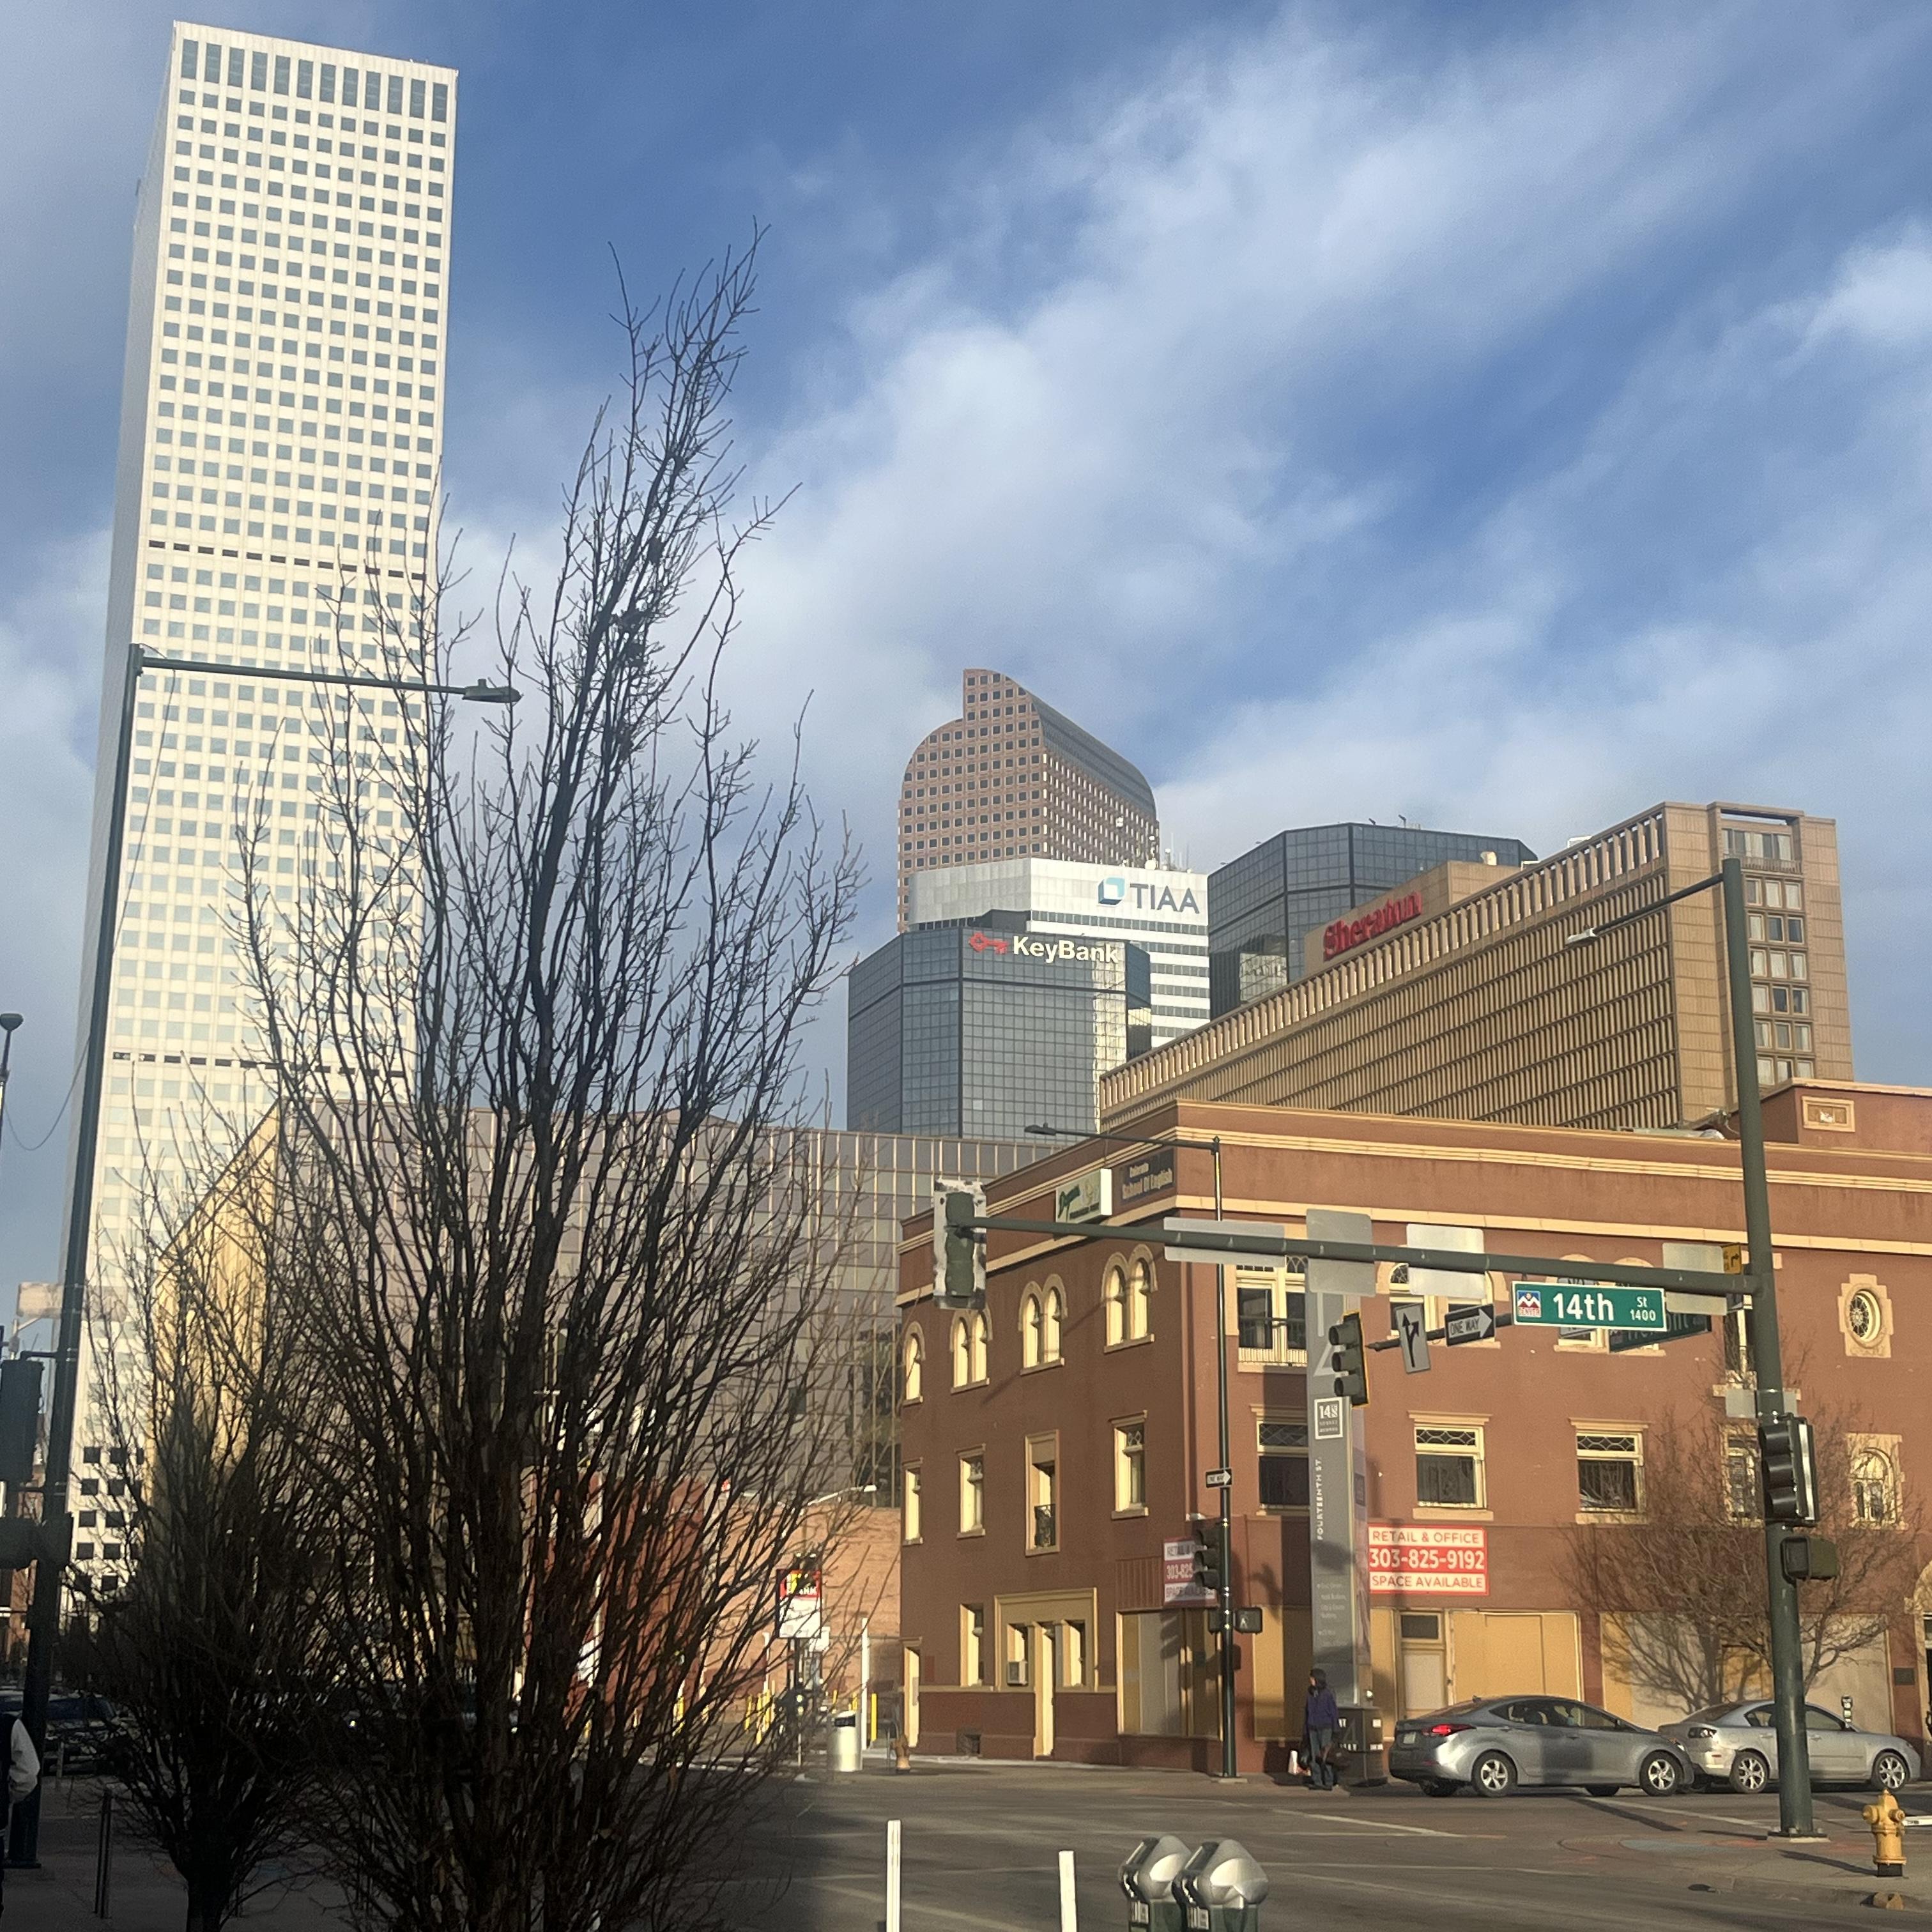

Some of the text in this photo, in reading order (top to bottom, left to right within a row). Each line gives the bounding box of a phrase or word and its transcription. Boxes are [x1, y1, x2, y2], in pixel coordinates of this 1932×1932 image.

[1130, 883, 1200, 914] TIAA
[1324, 891, 1422, 961] Sheraton
[1013, 935, 1119, 963] KeyBank
[1553, 1292, 1647, 1321] 14th St
[1630, 1309, 1656, 1322] 1400
[1450, 1316, 1480, 1335] ONE WAY
[1315, 1474, 1324, 1540] FOURTEENTH
[1373, 1531, 1479, 1544] RETAIL & OFFICE
[1369, 1548, 1485, 1570] 303-825-9192
[1372, 1575, 1483, 1588] SPACE AVAILABLE
